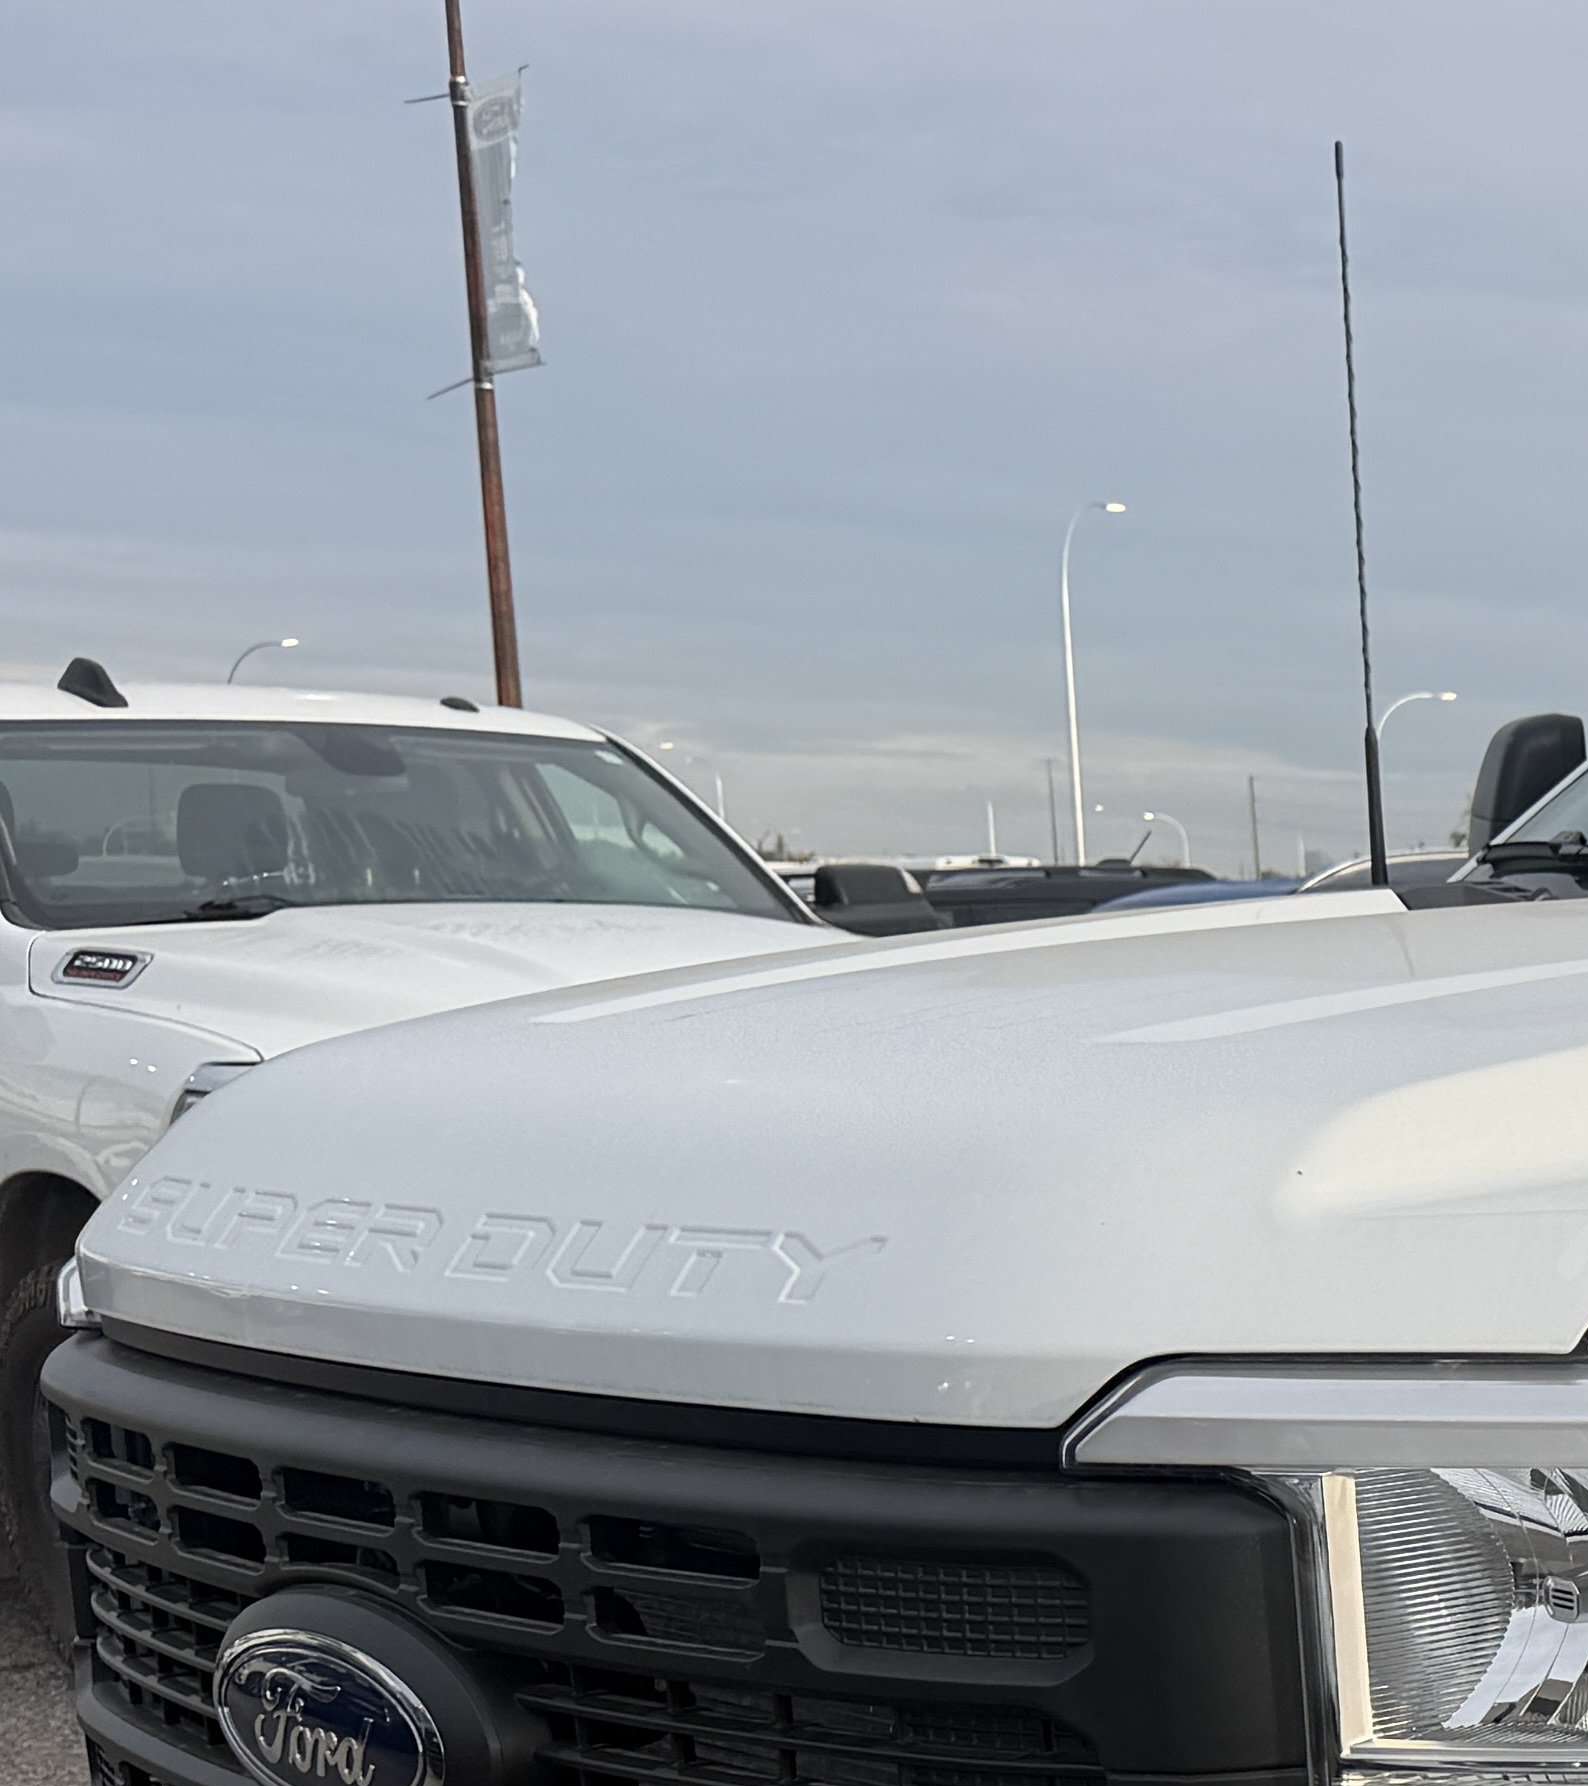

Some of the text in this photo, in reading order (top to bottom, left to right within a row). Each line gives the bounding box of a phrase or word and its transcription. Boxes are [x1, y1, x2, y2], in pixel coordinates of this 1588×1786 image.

[73, 954, 133, 971] 2500
[117, 1175, 888, 1305] SUPER DUTY
